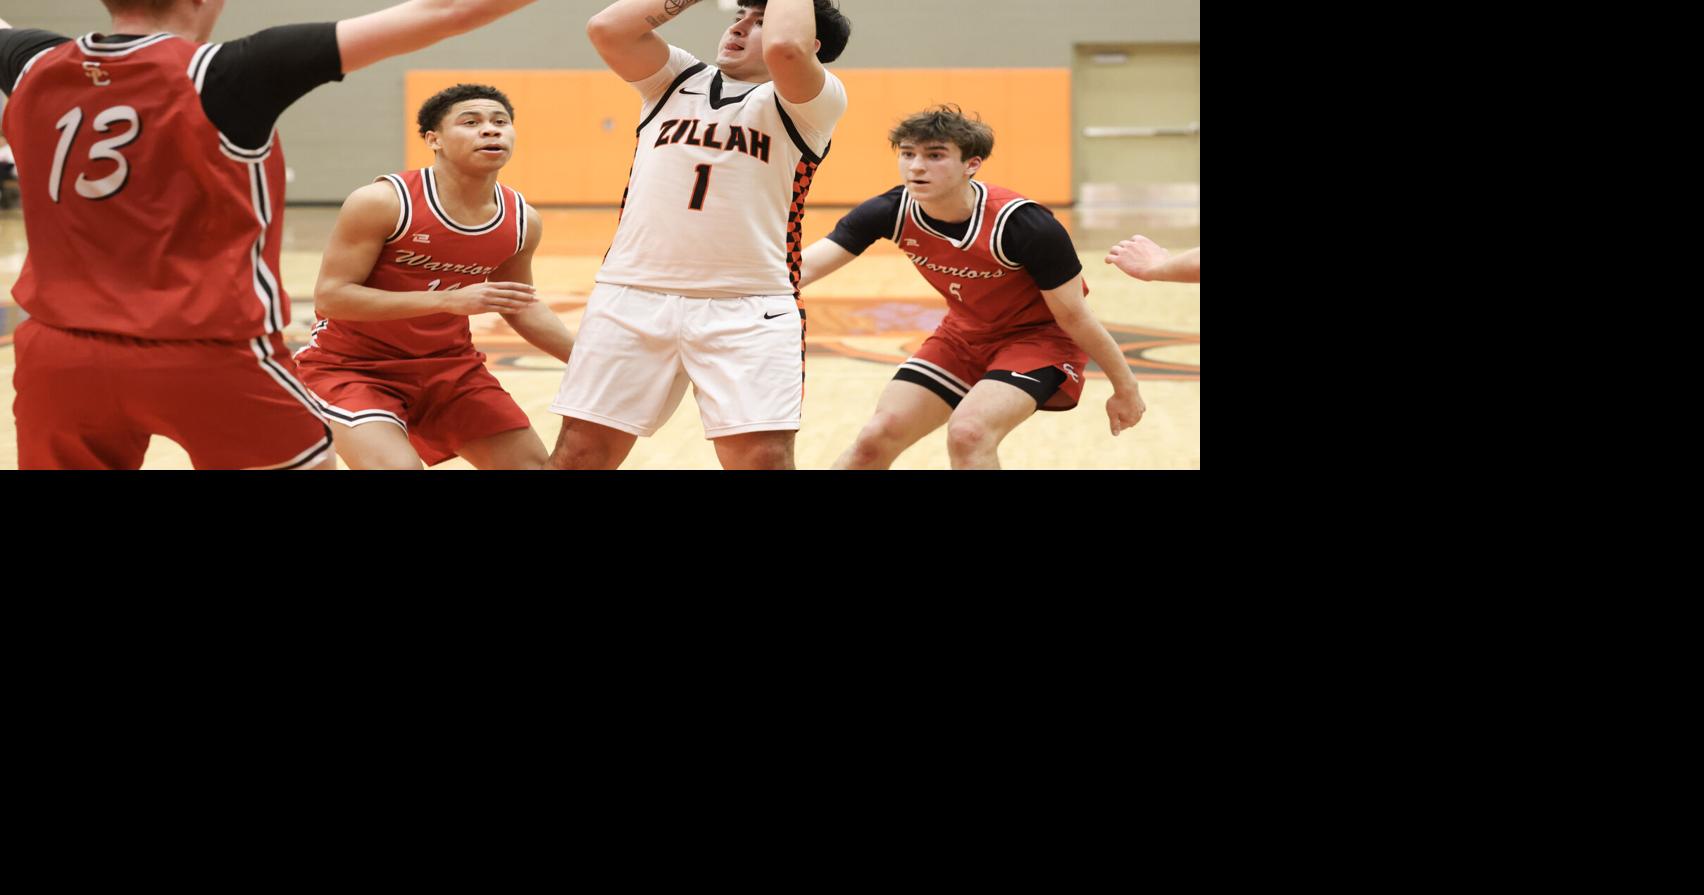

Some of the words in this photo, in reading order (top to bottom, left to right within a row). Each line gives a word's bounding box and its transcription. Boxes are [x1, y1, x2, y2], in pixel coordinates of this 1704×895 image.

[48, 105, 142, 203] 13
[653, 119, 771, 164] ZILLAH
[687, 163, 713, 212] 1
[395, 249, 498, 276] Warrior
